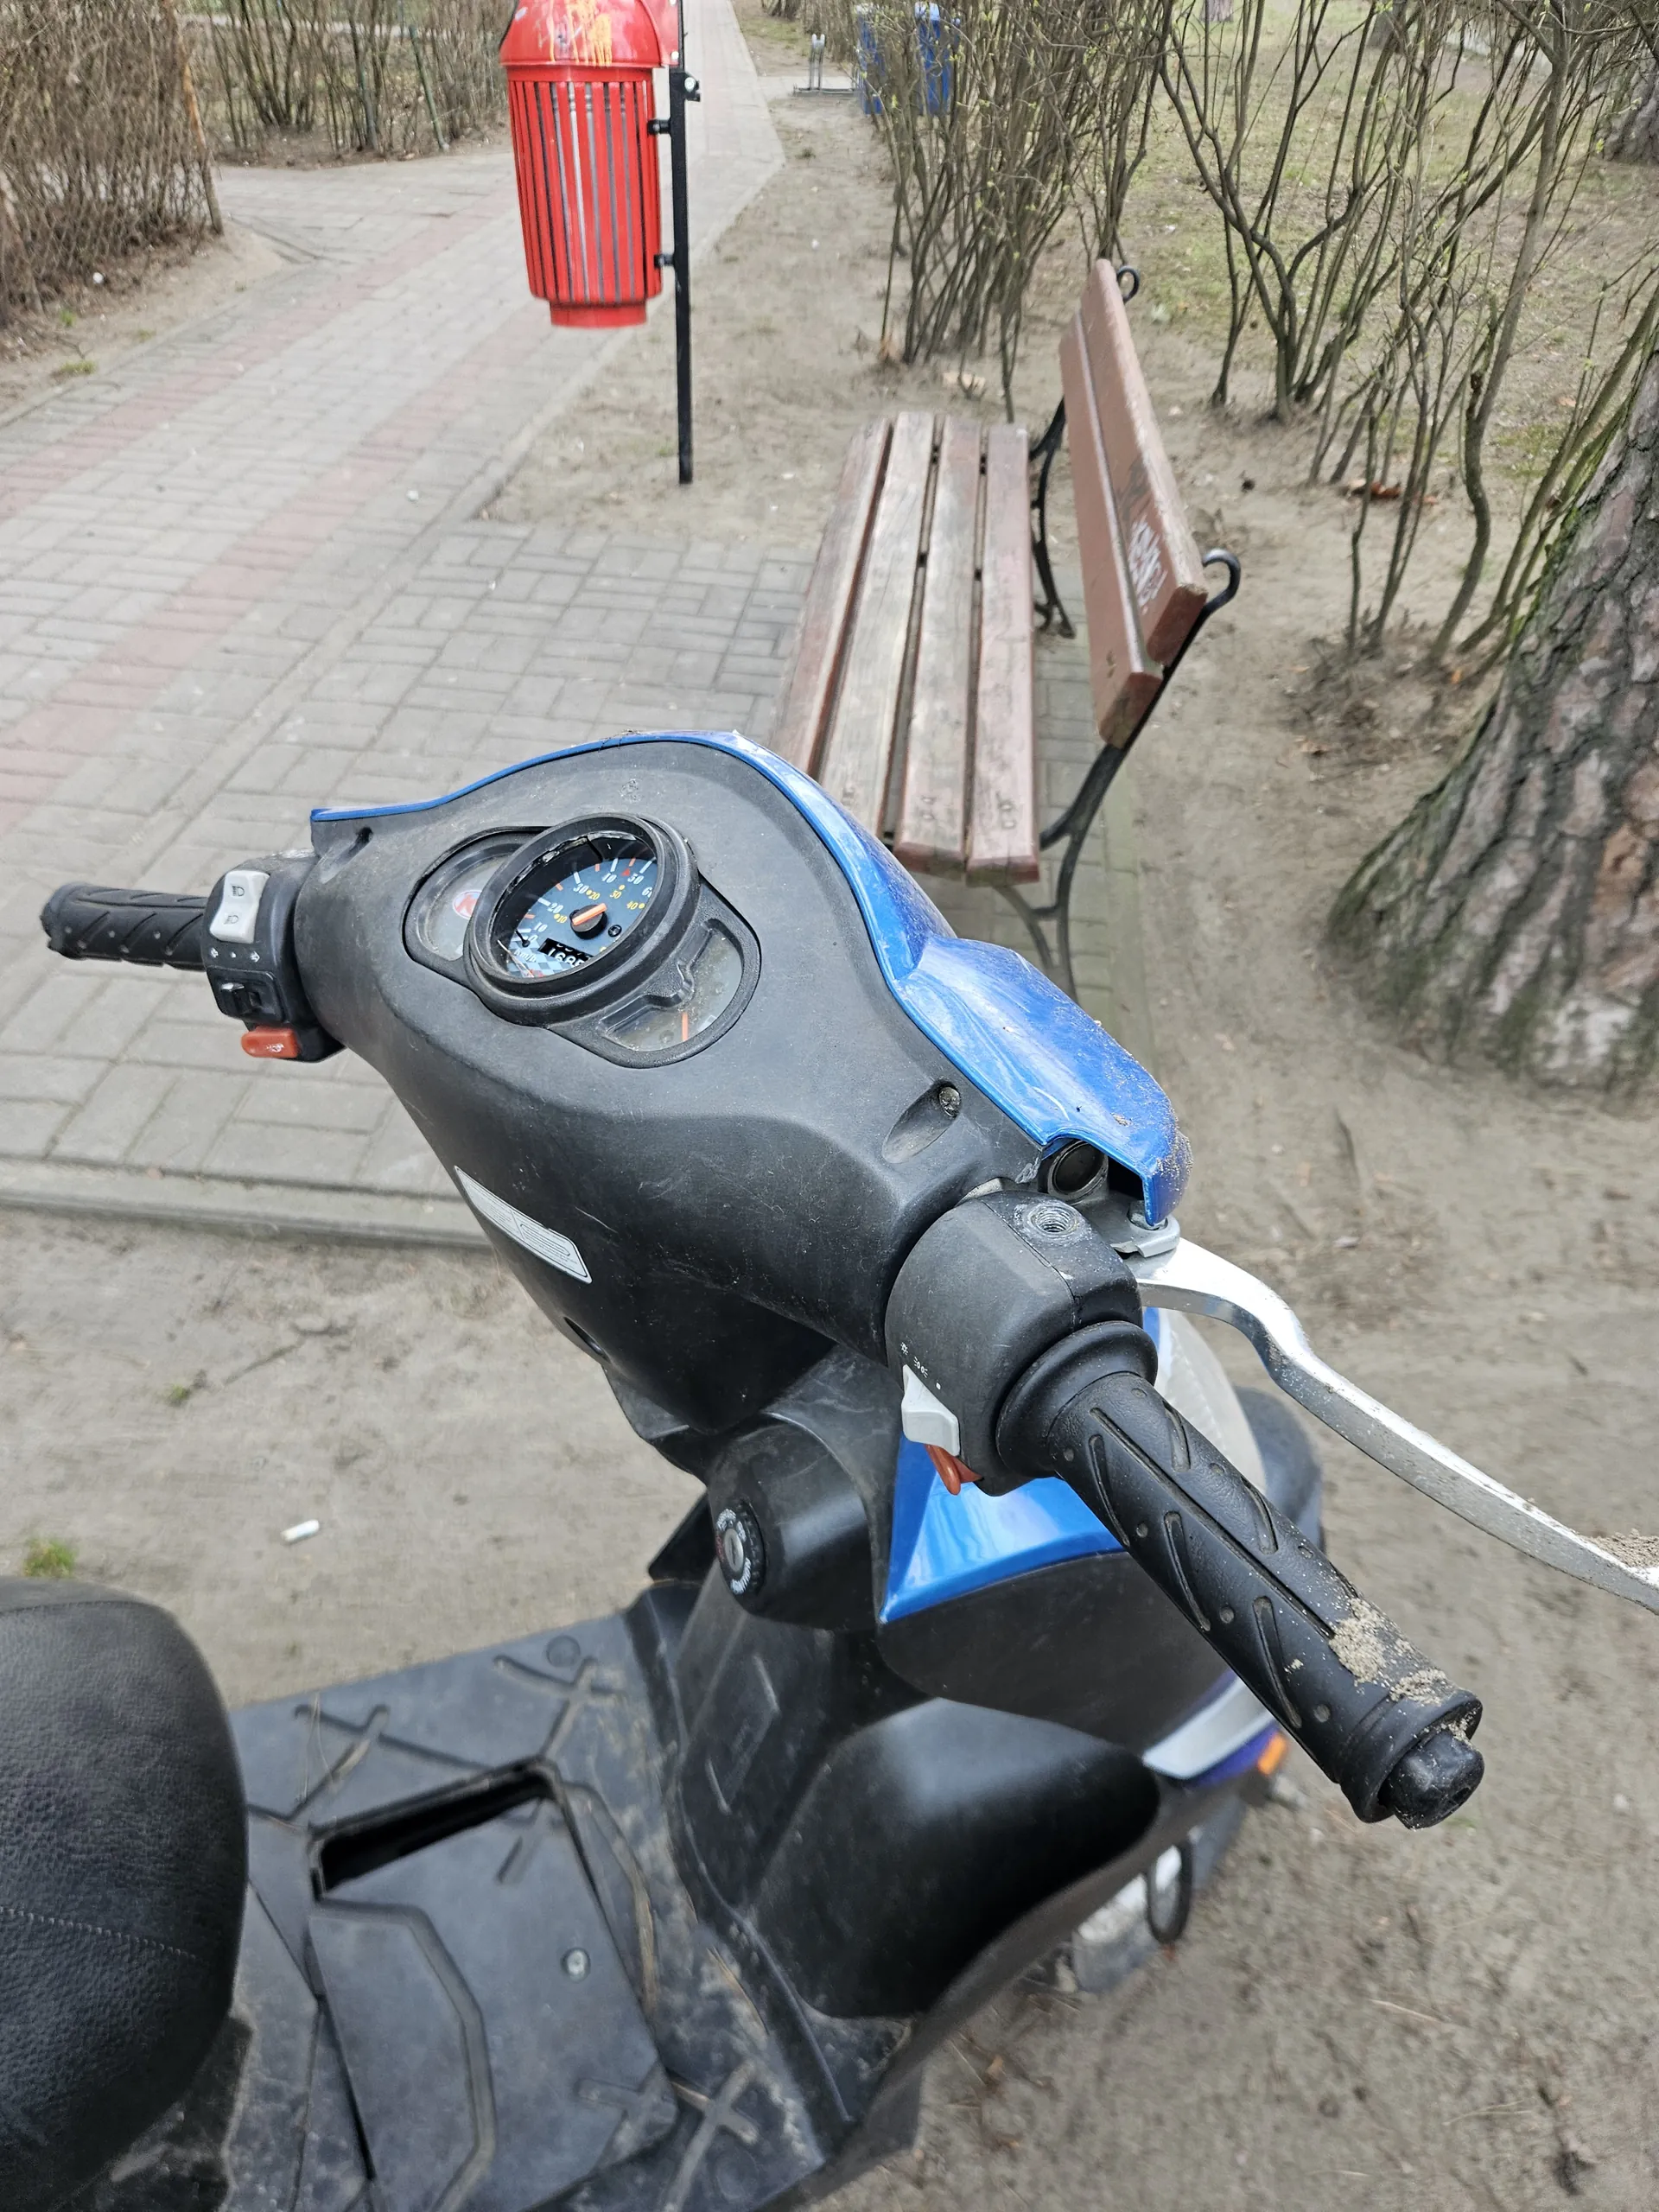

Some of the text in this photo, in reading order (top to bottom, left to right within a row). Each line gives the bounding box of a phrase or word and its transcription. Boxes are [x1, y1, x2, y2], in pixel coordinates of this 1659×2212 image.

[627, 873, 645, 885] 50
[573, 882, 589, 894] 30
[547, 902, 564, 913] 20
[556, 915, 568, 924] 10
[534, 921, 548, 932] 10
